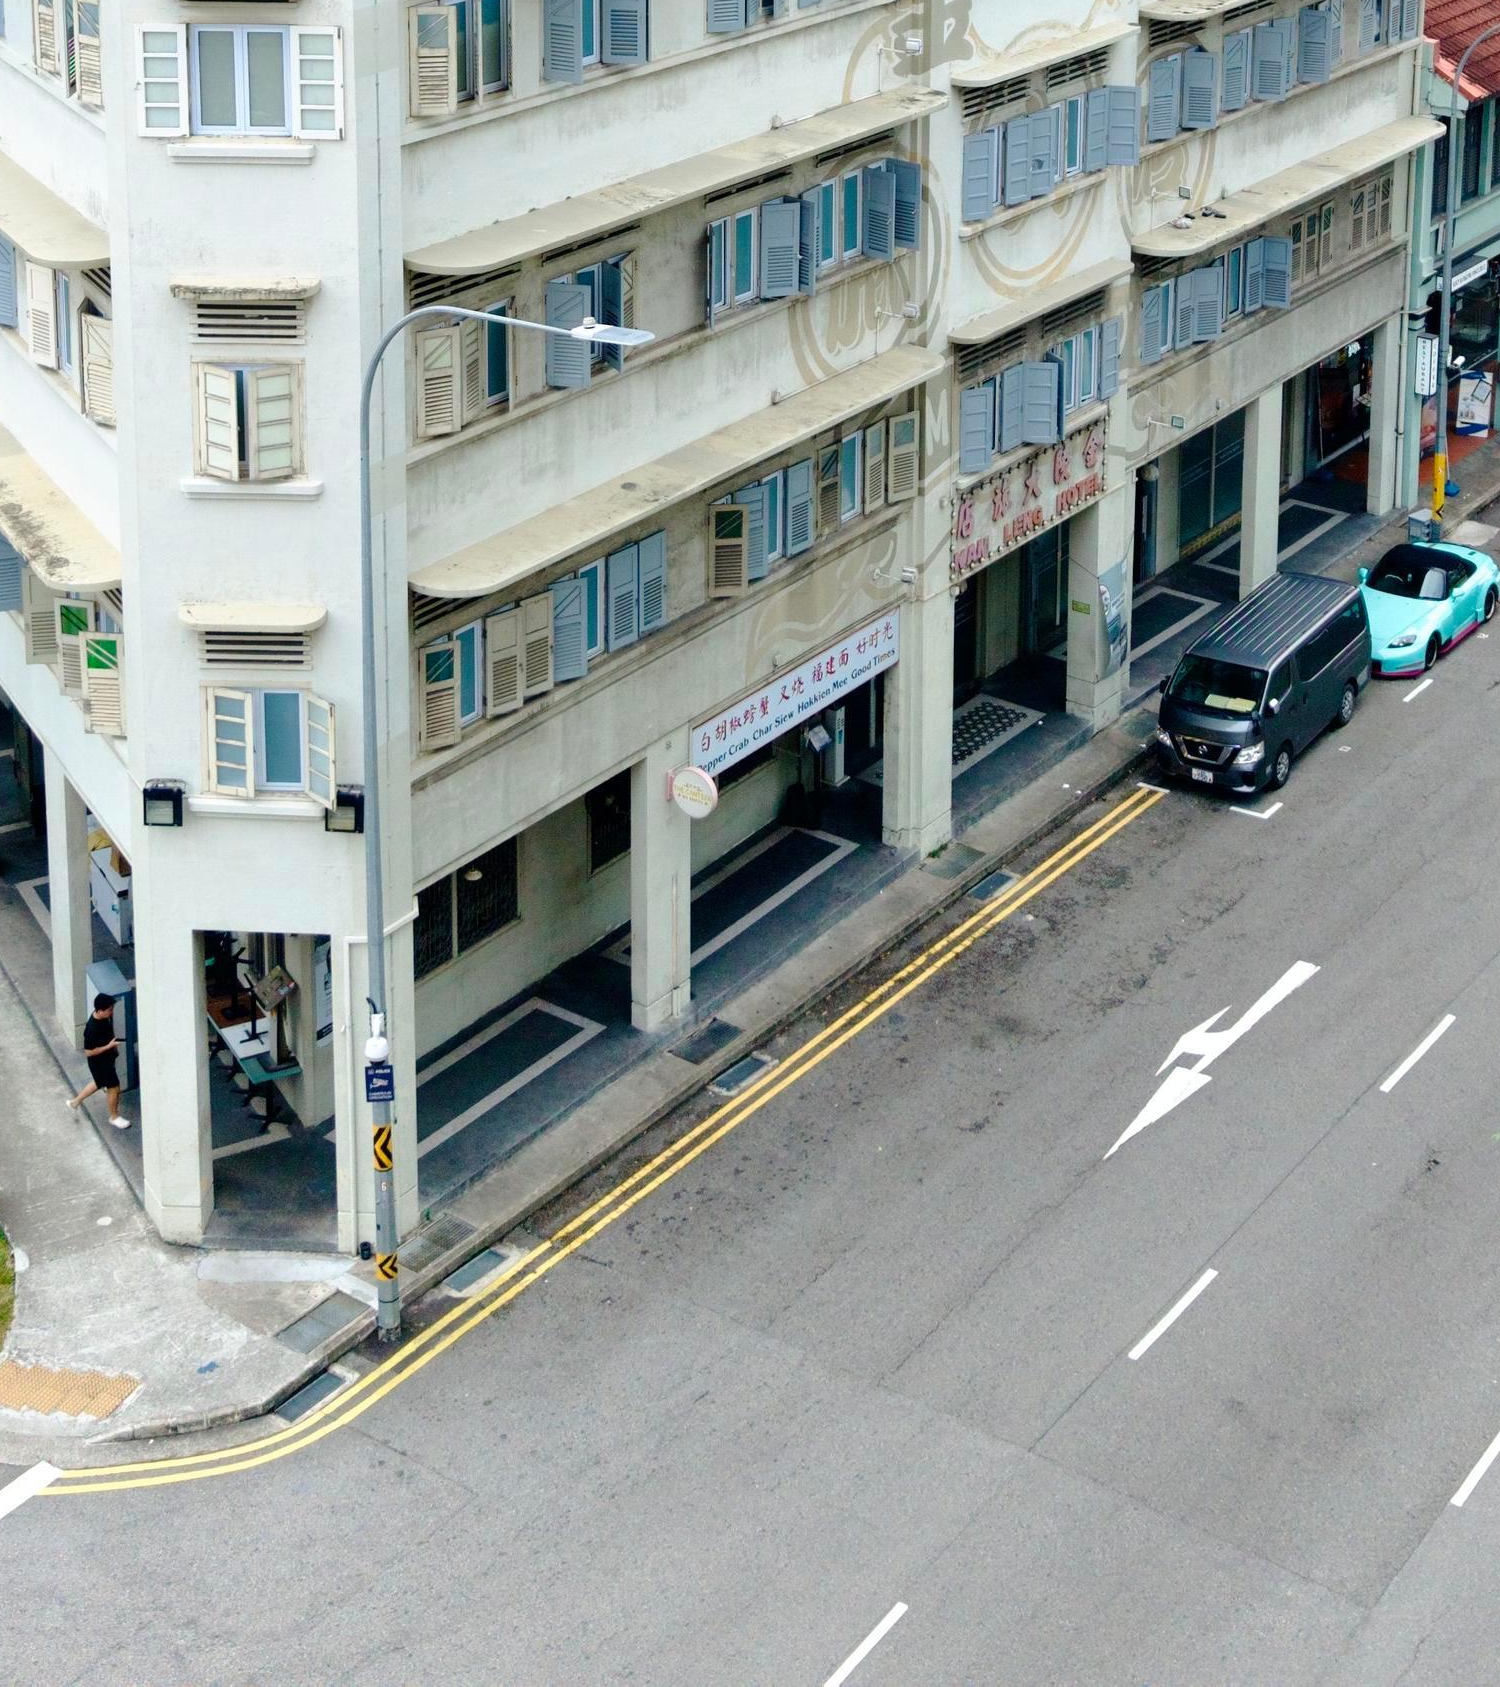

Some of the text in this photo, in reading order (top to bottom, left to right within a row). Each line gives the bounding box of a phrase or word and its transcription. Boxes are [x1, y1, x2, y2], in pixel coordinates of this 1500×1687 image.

[1003, 505, 1043, 544] LENG
[1056, 472, 1100, 517] HOTEL
[811, 648, 850, 684] 福建面
[855, 620, 894, 655] 好时光
[728, 738, 750, 756] Crab
[752, 723, 774, 741] Char
[774, 710, 795, 728] Siew
[797, 688, 831, 714] Hokkien
[832, 677, 848, 691] Mee
[851, 662, 872, 679] Good
[873, 647, 896, 664] Times
